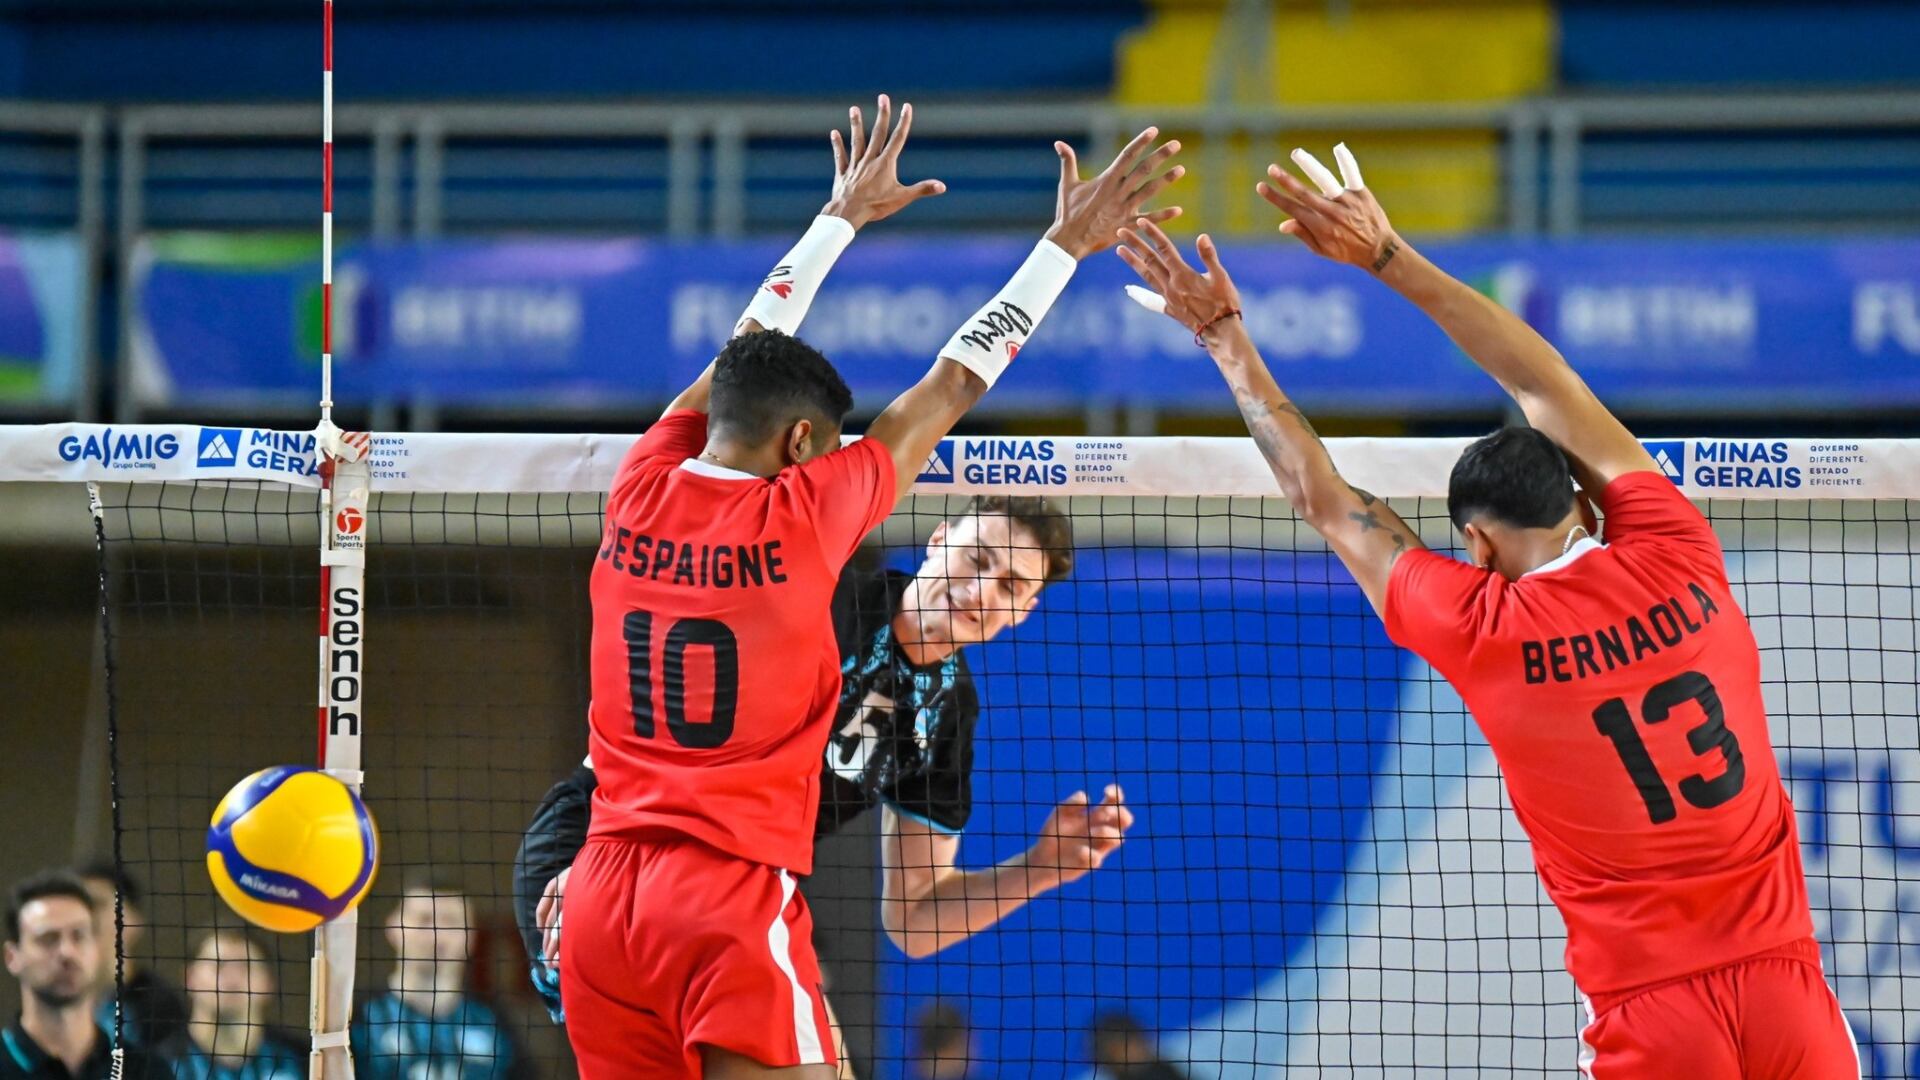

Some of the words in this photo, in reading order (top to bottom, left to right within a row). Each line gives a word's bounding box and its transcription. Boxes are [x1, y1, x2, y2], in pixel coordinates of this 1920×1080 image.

[58, 427, 180, 468] GASMIG
[250, 430, 318, 454] MINA
[964, 440, 1055, 461] MINAS
[1694, 441, 1788, 463] MINAS
[112, 461, 133, 469] Grupo
[247, 449, 321, 476] GERA
[369, 460, 395, 468] TADO
[963, 464, 1067, 485] GERAIS
[1694, 466, 1801, 488] GERAIS
[333, 540, 364, 549] Imports
[336, 533, 361, 541] Sports
[1521, 582, 1719, 685] BERNAOLA
[329, 587, 360, 736] Senoh
[622, 610, 739, 749] 10
[1591, 670, 1746, 825] 13
